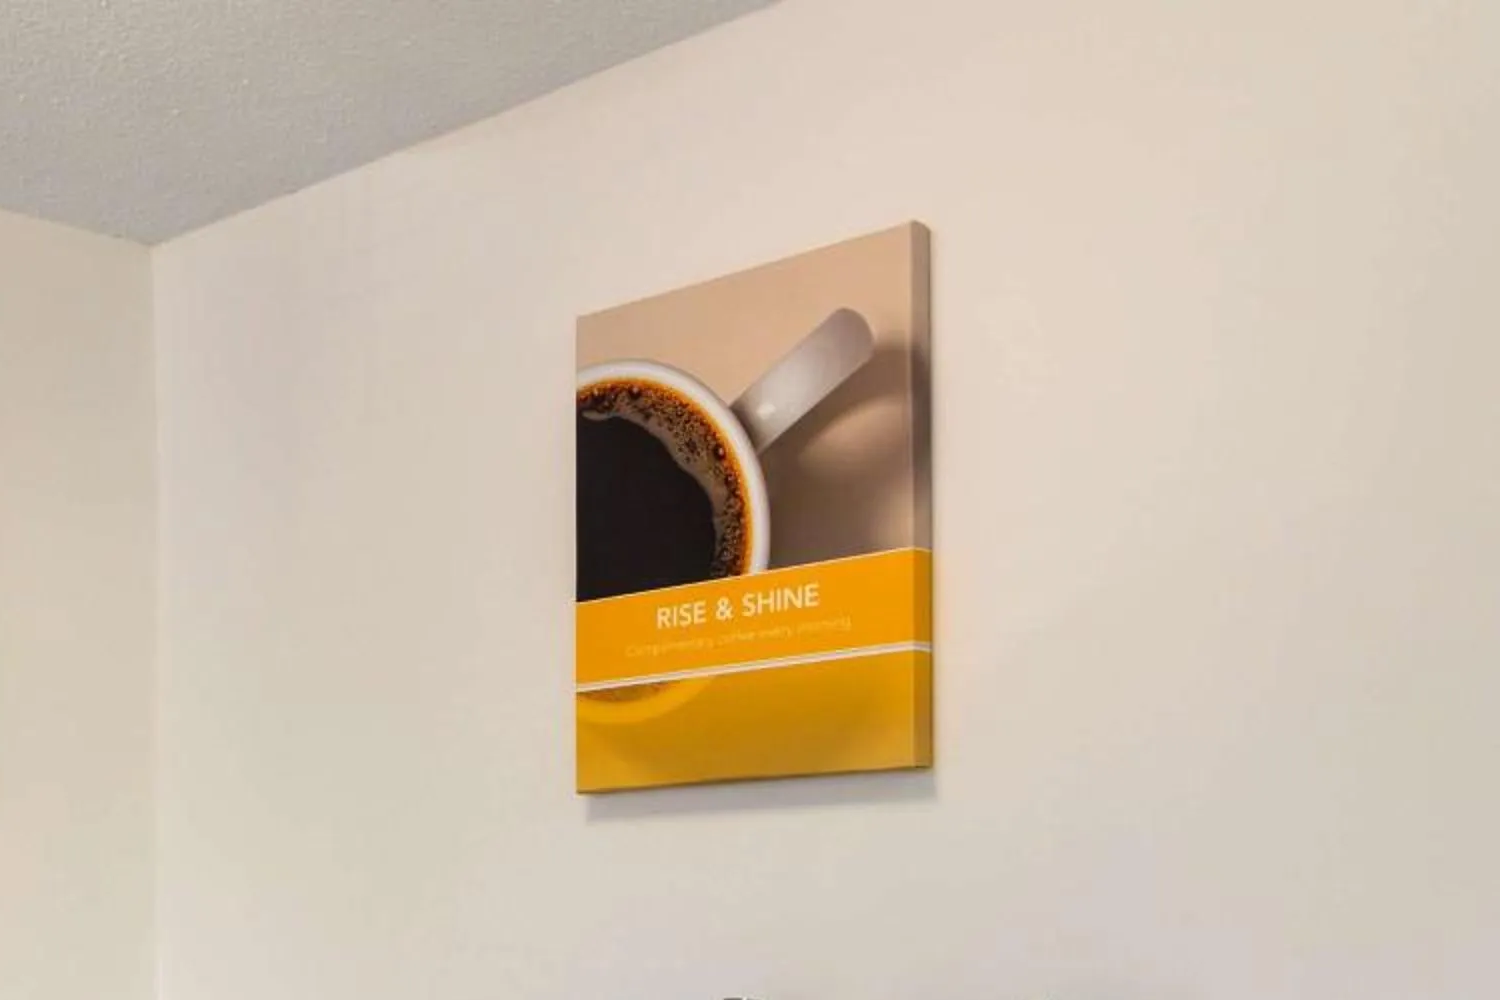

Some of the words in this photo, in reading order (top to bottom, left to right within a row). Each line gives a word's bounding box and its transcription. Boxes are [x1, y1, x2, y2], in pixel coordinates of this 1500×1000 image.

[656, 601, 707, 630] RISE
[715, 596, 734, 622] &
[741, 583, 821, 618] SHINE
